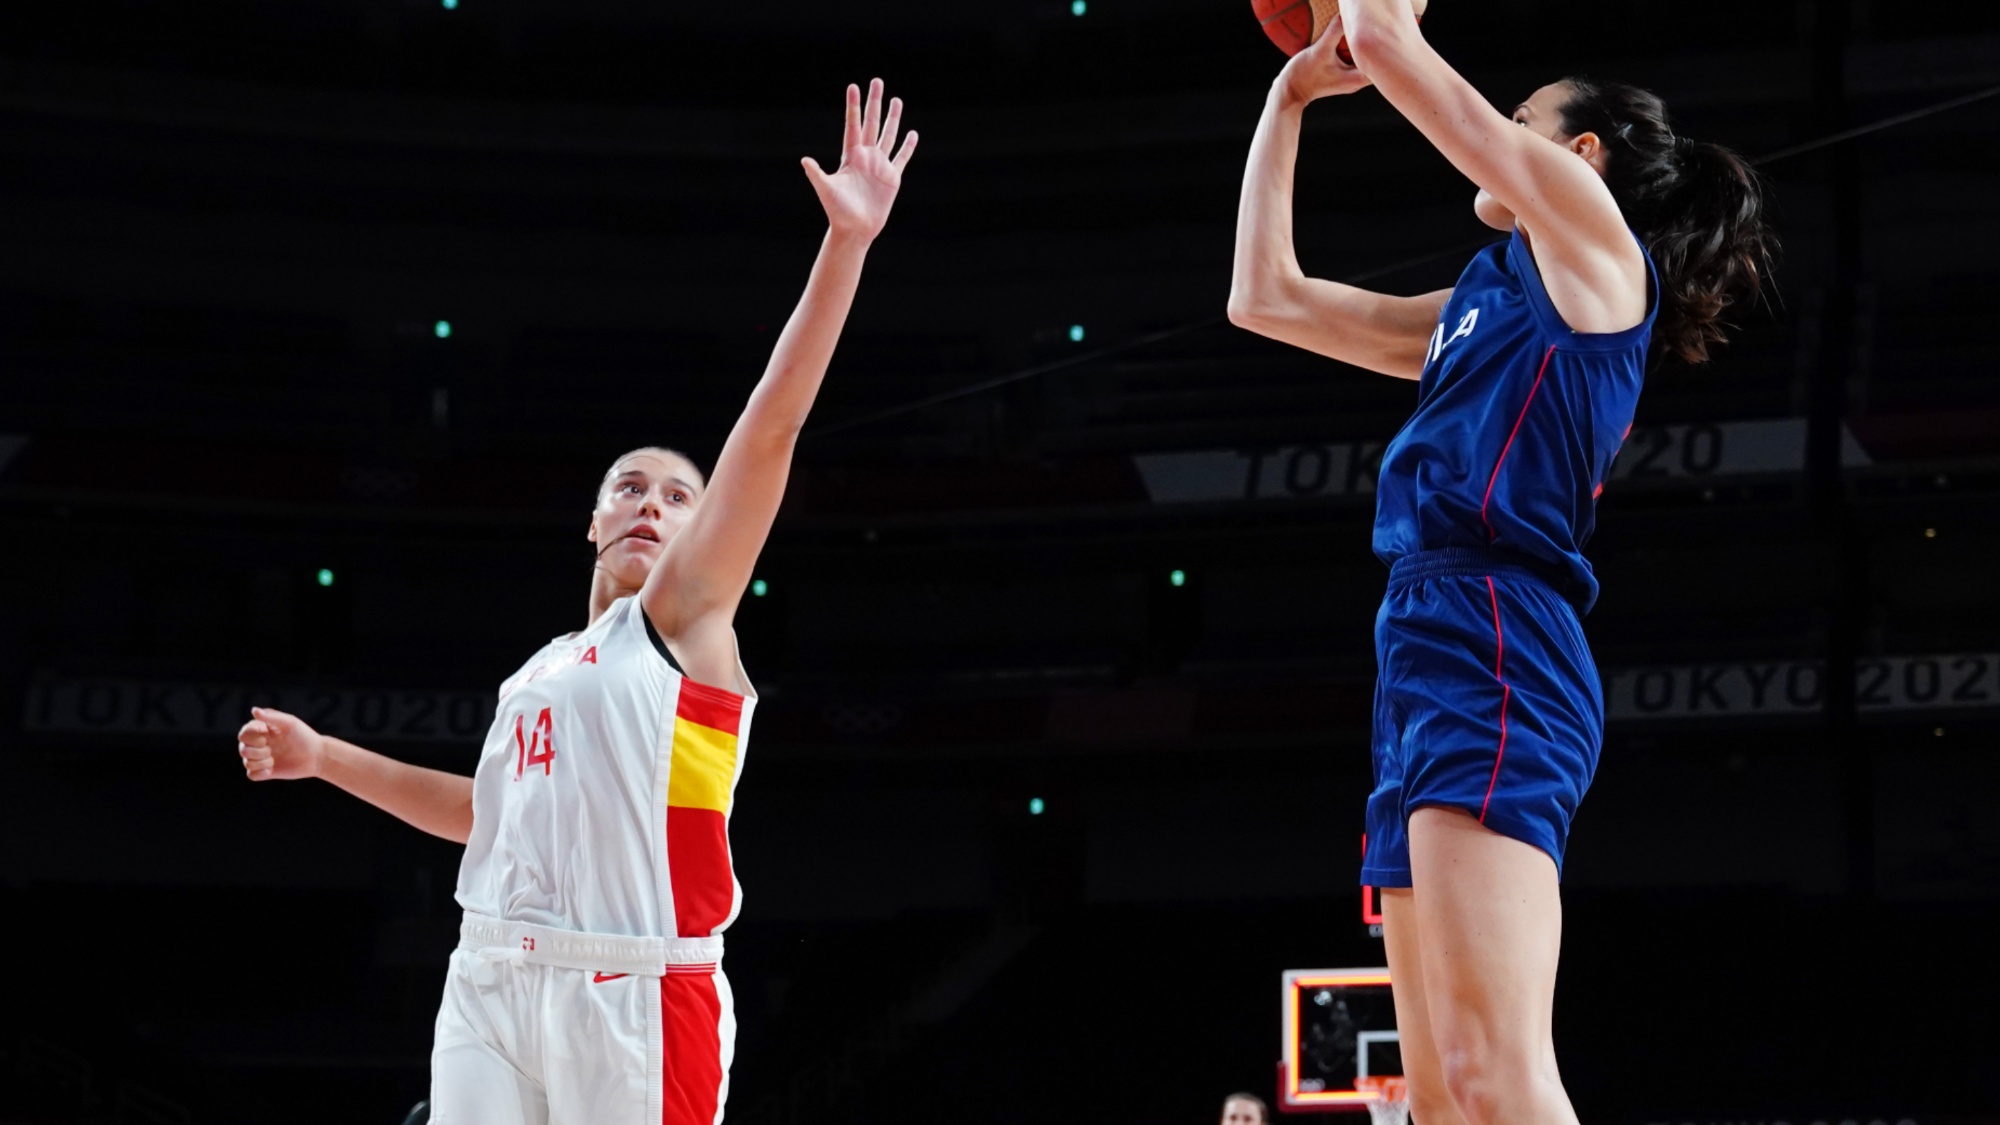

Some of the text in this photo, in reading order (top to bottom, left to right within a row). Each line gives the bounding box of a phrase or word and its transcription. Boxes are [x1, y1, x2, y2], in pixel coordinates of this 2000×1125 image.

[1235, 423, 1721, 497] TOK 20
[1854, 657, 2000, 704] 202
[307, 690, 484, 736] 2020
[514, 707, 556, 781] 14
